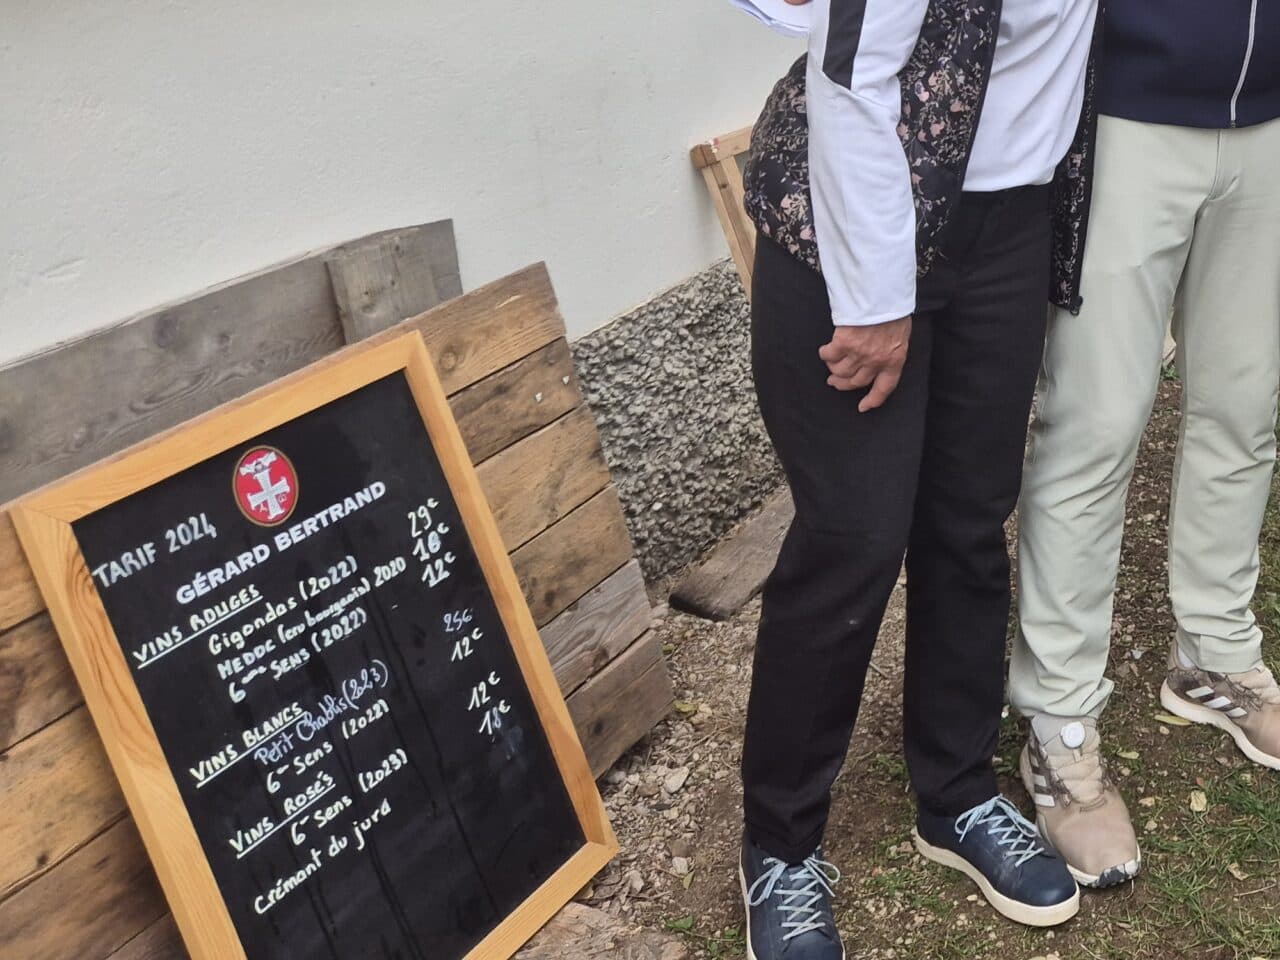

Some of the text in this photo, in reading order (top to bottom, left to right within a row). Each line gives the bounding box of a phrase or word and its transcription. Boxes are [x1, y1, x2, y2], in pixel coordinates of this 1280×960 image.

[92, 513, 217, 587] TARIF 2024
[176, 481, 386, 604] GÉRARD BERTRAND
[209, 497, 439, 655] Gigondas (2022) 29€
[133, 584, 260, 662] VINS ROUGES
[311, 607, 367, 652] (2022)
[422, 551, 456, 588] 12€
[217, 639, 276, 680] MEDOC
[451, 628, 483, 662] 12€
[189, 701, 302, 781] VINS BLANCS
[358, 748, 408, 793] (2023)
[468, 671, 500, 712] 12€
[328, 835, 348, 857] du
